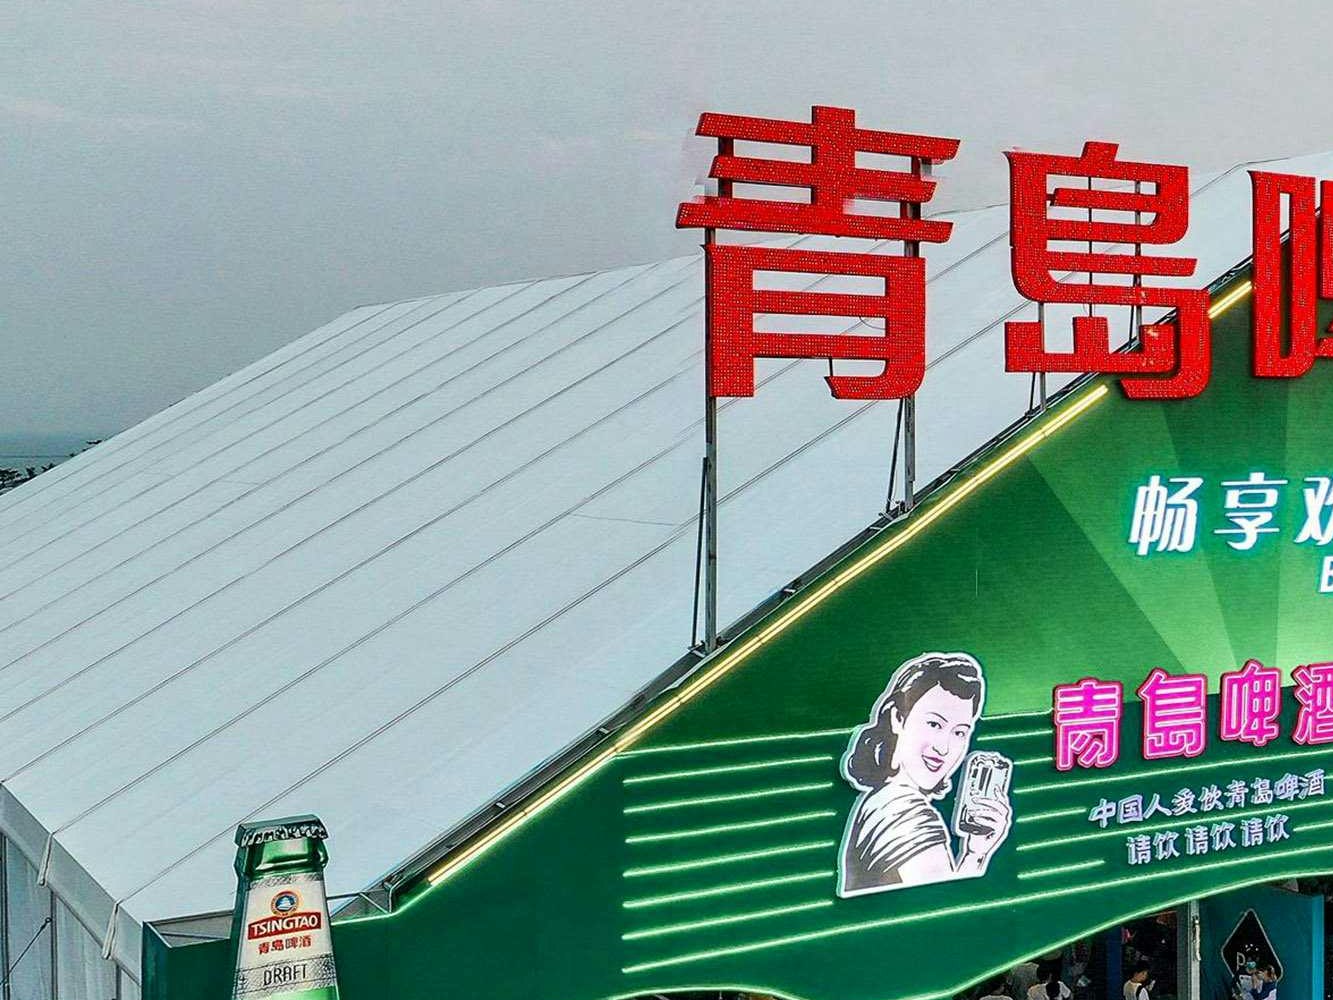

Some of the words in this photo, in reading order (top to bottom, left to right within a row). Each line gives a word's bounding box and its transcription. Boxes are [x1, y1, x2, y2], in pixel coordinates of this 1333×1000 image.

[1126, 831, 1180, 866] 请饮
[1183, 822, 1237, 858] 请饮
[1240, 814, 1290, 848] 请饮
[251, 915, 318, 936] TSINGTAO
[263, 964, 308, 986] DRAFT
